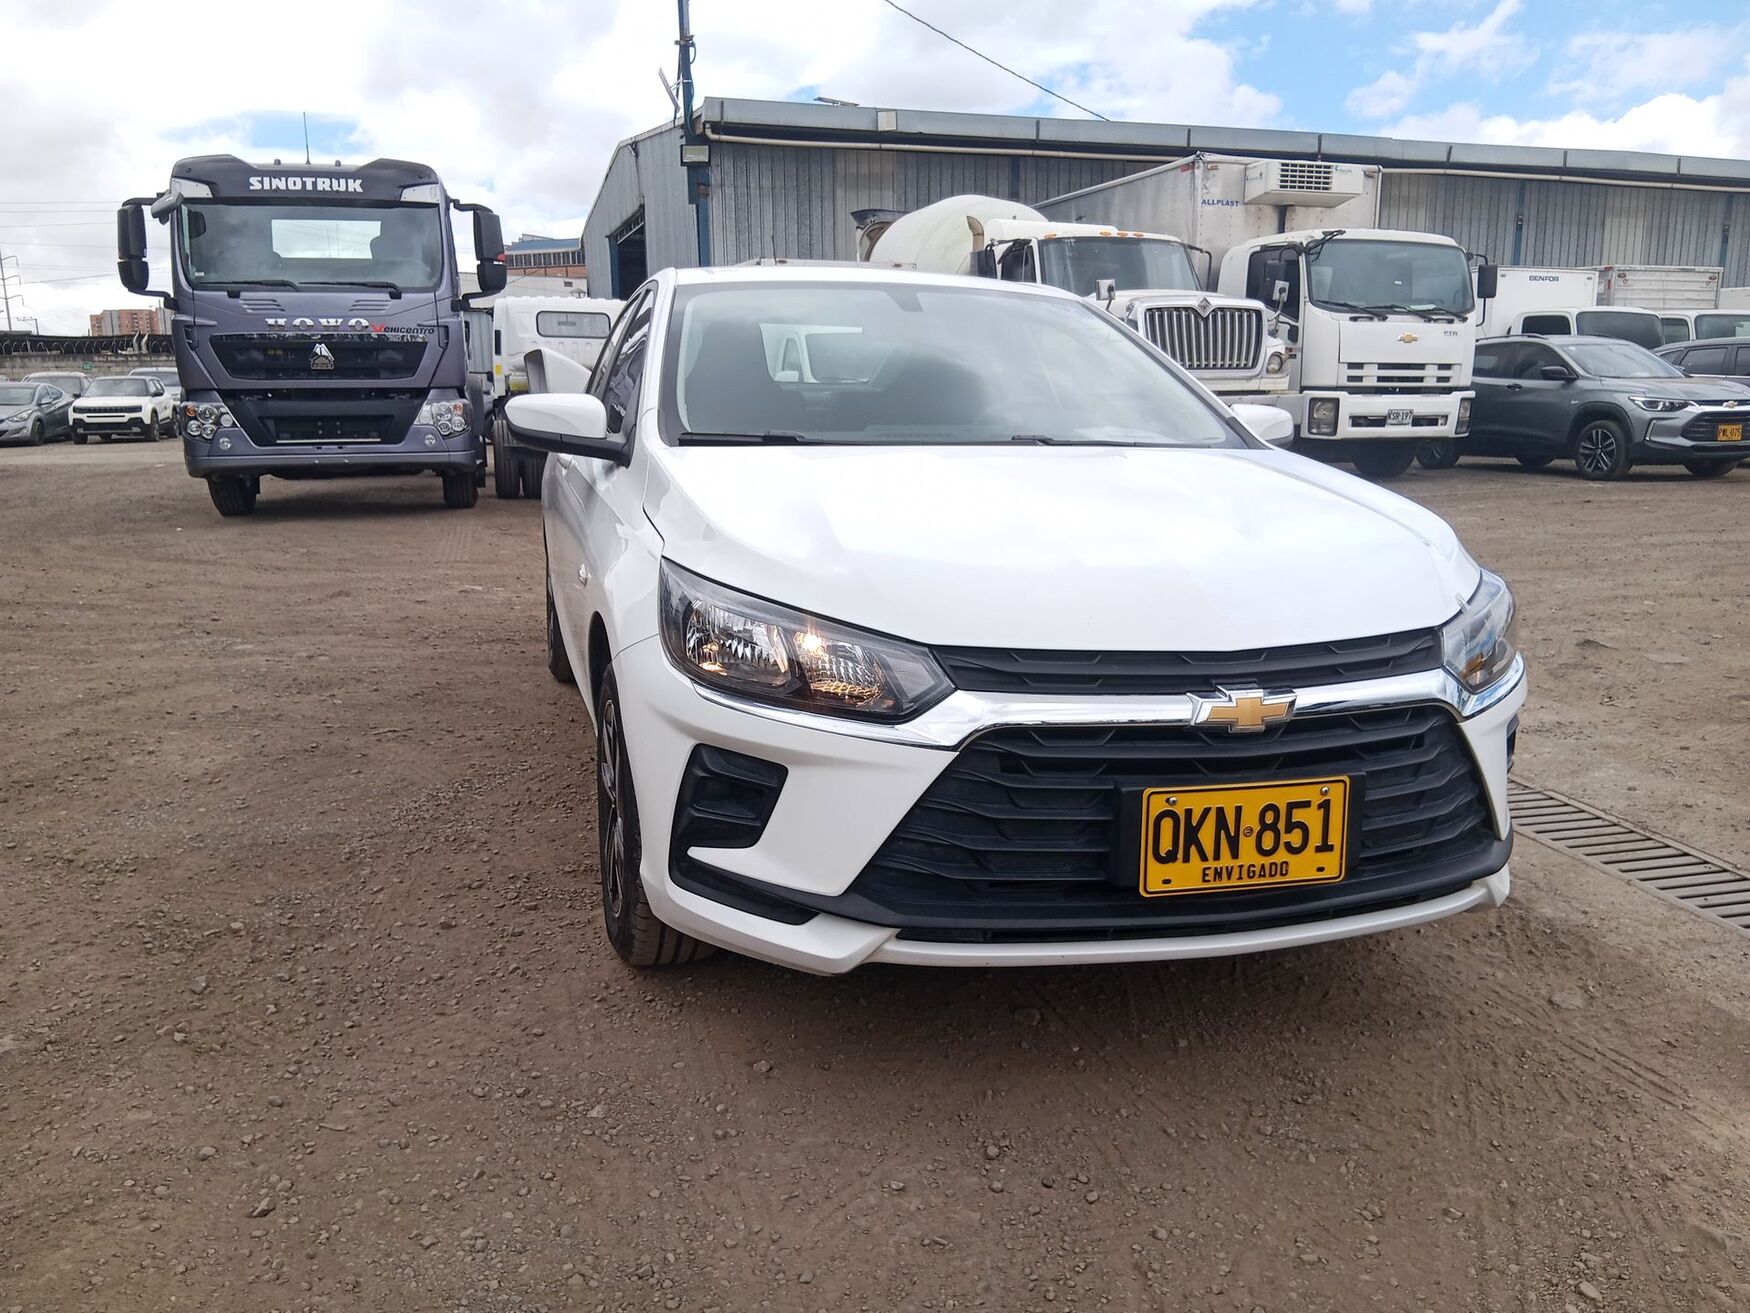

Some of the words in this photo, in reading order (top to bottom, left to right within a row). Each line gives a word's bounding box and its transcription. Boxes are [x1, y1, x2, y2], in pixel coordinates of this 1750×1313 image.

[249, 176, 364, 193] SINOTRUK
[1201, 199, 1240, 207] ALLPLAST
[264, 317, 370, 331] HOWO
[1152, 805, 1243, 865] QKN
[1255, 798, 1335, 857] 851
[1201, 860, 1289, 883] ENVIGADO
